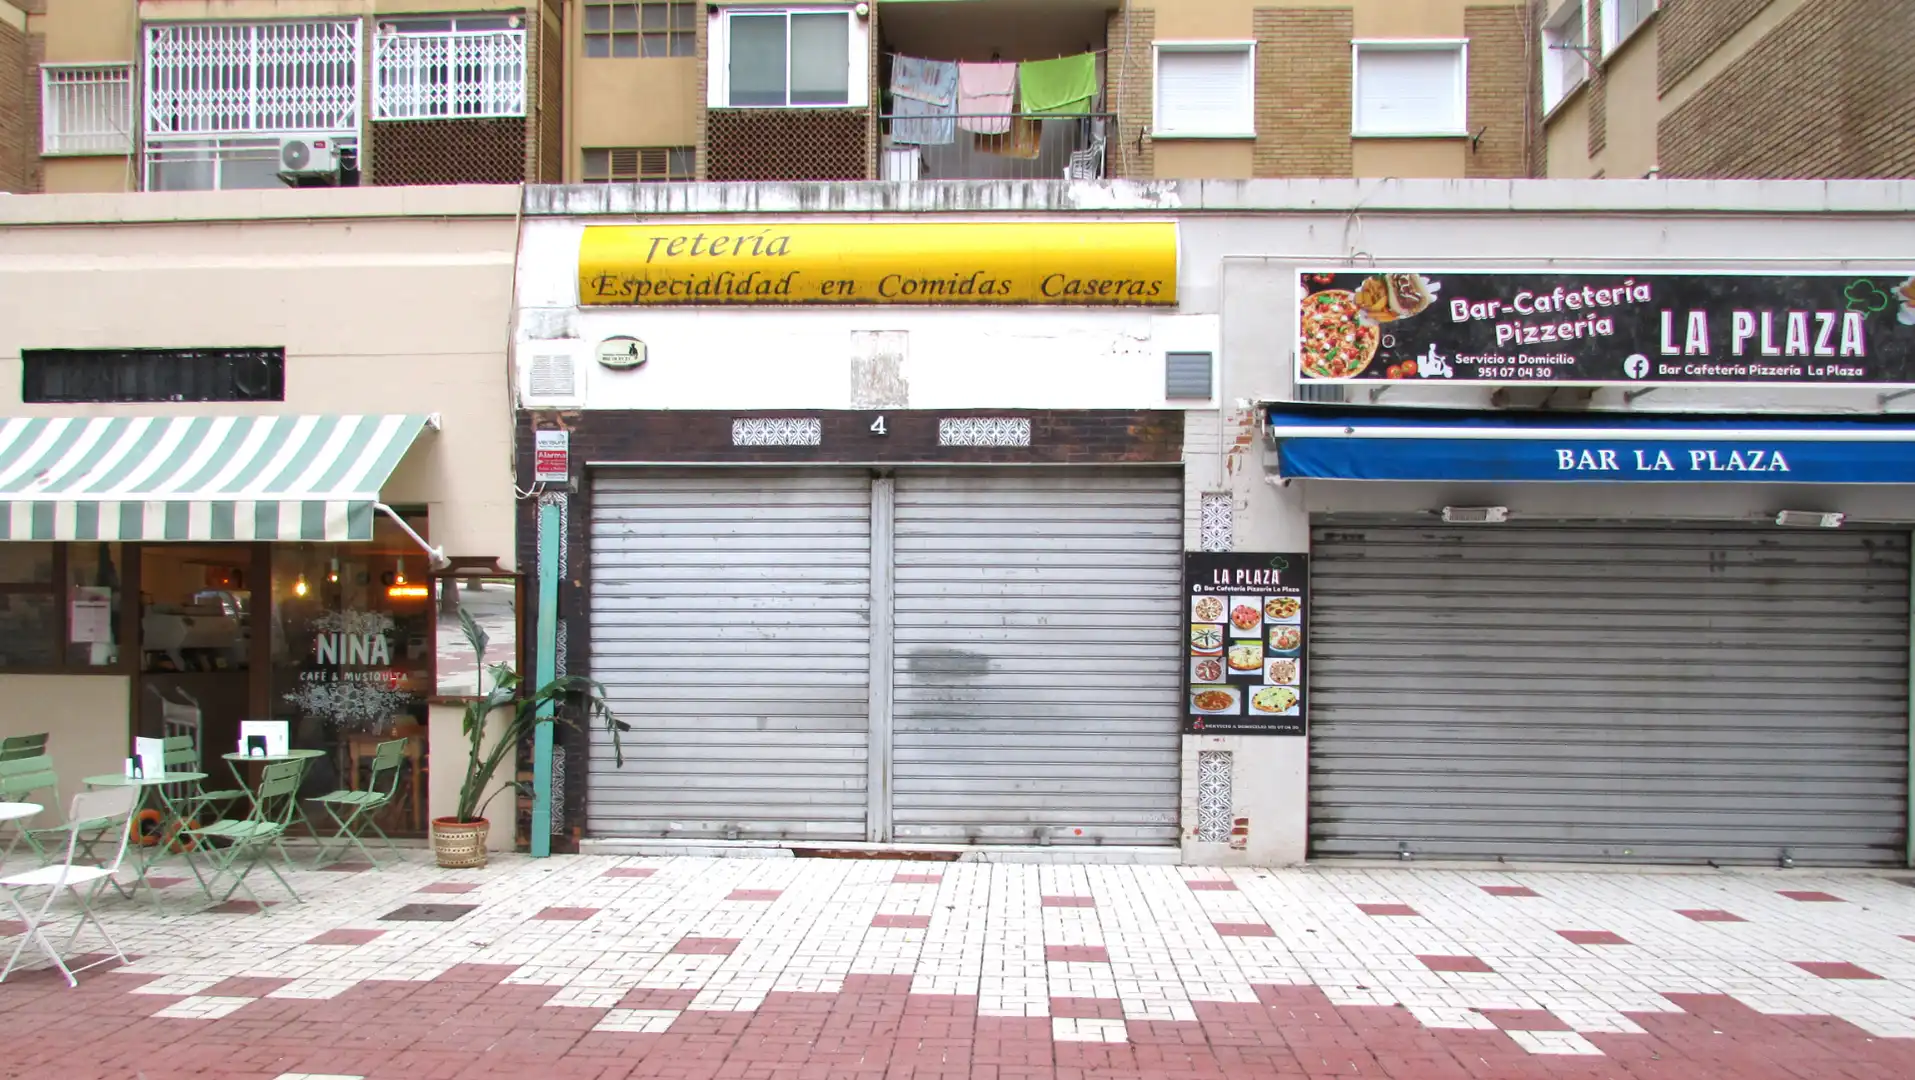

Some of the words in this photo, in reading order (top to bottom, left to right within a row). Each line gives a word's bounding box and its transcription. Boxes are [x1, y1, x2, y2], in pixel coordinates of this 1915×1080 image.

[591, 270, 800, 303] Especialidad
[820, 278, 856, 296] en
[878, 270, 1012, 297] Comidas
[1040, 273, 1163, 297] Caseras
[1450, 278, 1652, 323] Bar-Cafetería
[1495, 313, 1614, 347] Pizzería
[1660, 310, 1709, 356] LA
[1731, 310, 1865, 357] PLAZA
[1455, 353, 1505, 365] Servicio
[1507, 355, 1515, 365] a
[1518, 353, 1575, 365] Domicilio
[1478, 367, 1498, 378] 951
[1499, 367, 1514, 378] 07
[1517, 367, 1533, 378] 04
[1535, 367, 1551, 378] 30
[1658, 364, 1682, 376] Bar
[1684, 363, 1746, 376] Cafetería
[1749, 364, 1801, 377] Pizzería
[1807, 365, 1824, 377] La
[1826, 364, 1863, 377] Plaza
[870, 416, 887, 435] 4
[1556, 449, 1619, 471] BAR
[1633, 449, 1675, 471] LA
[1688, 449, 1790, 472] PLAZA
[1213, 568, 1230, 585] LA
[1236, 569, 1281, 585] PLAZA
[317, 633, 390, 665] NINA
[300, 669, 327, 681] CAFÉ
[332, 672, 339, 681] &
[343, 671, 408, 681] MUSIQUITA
